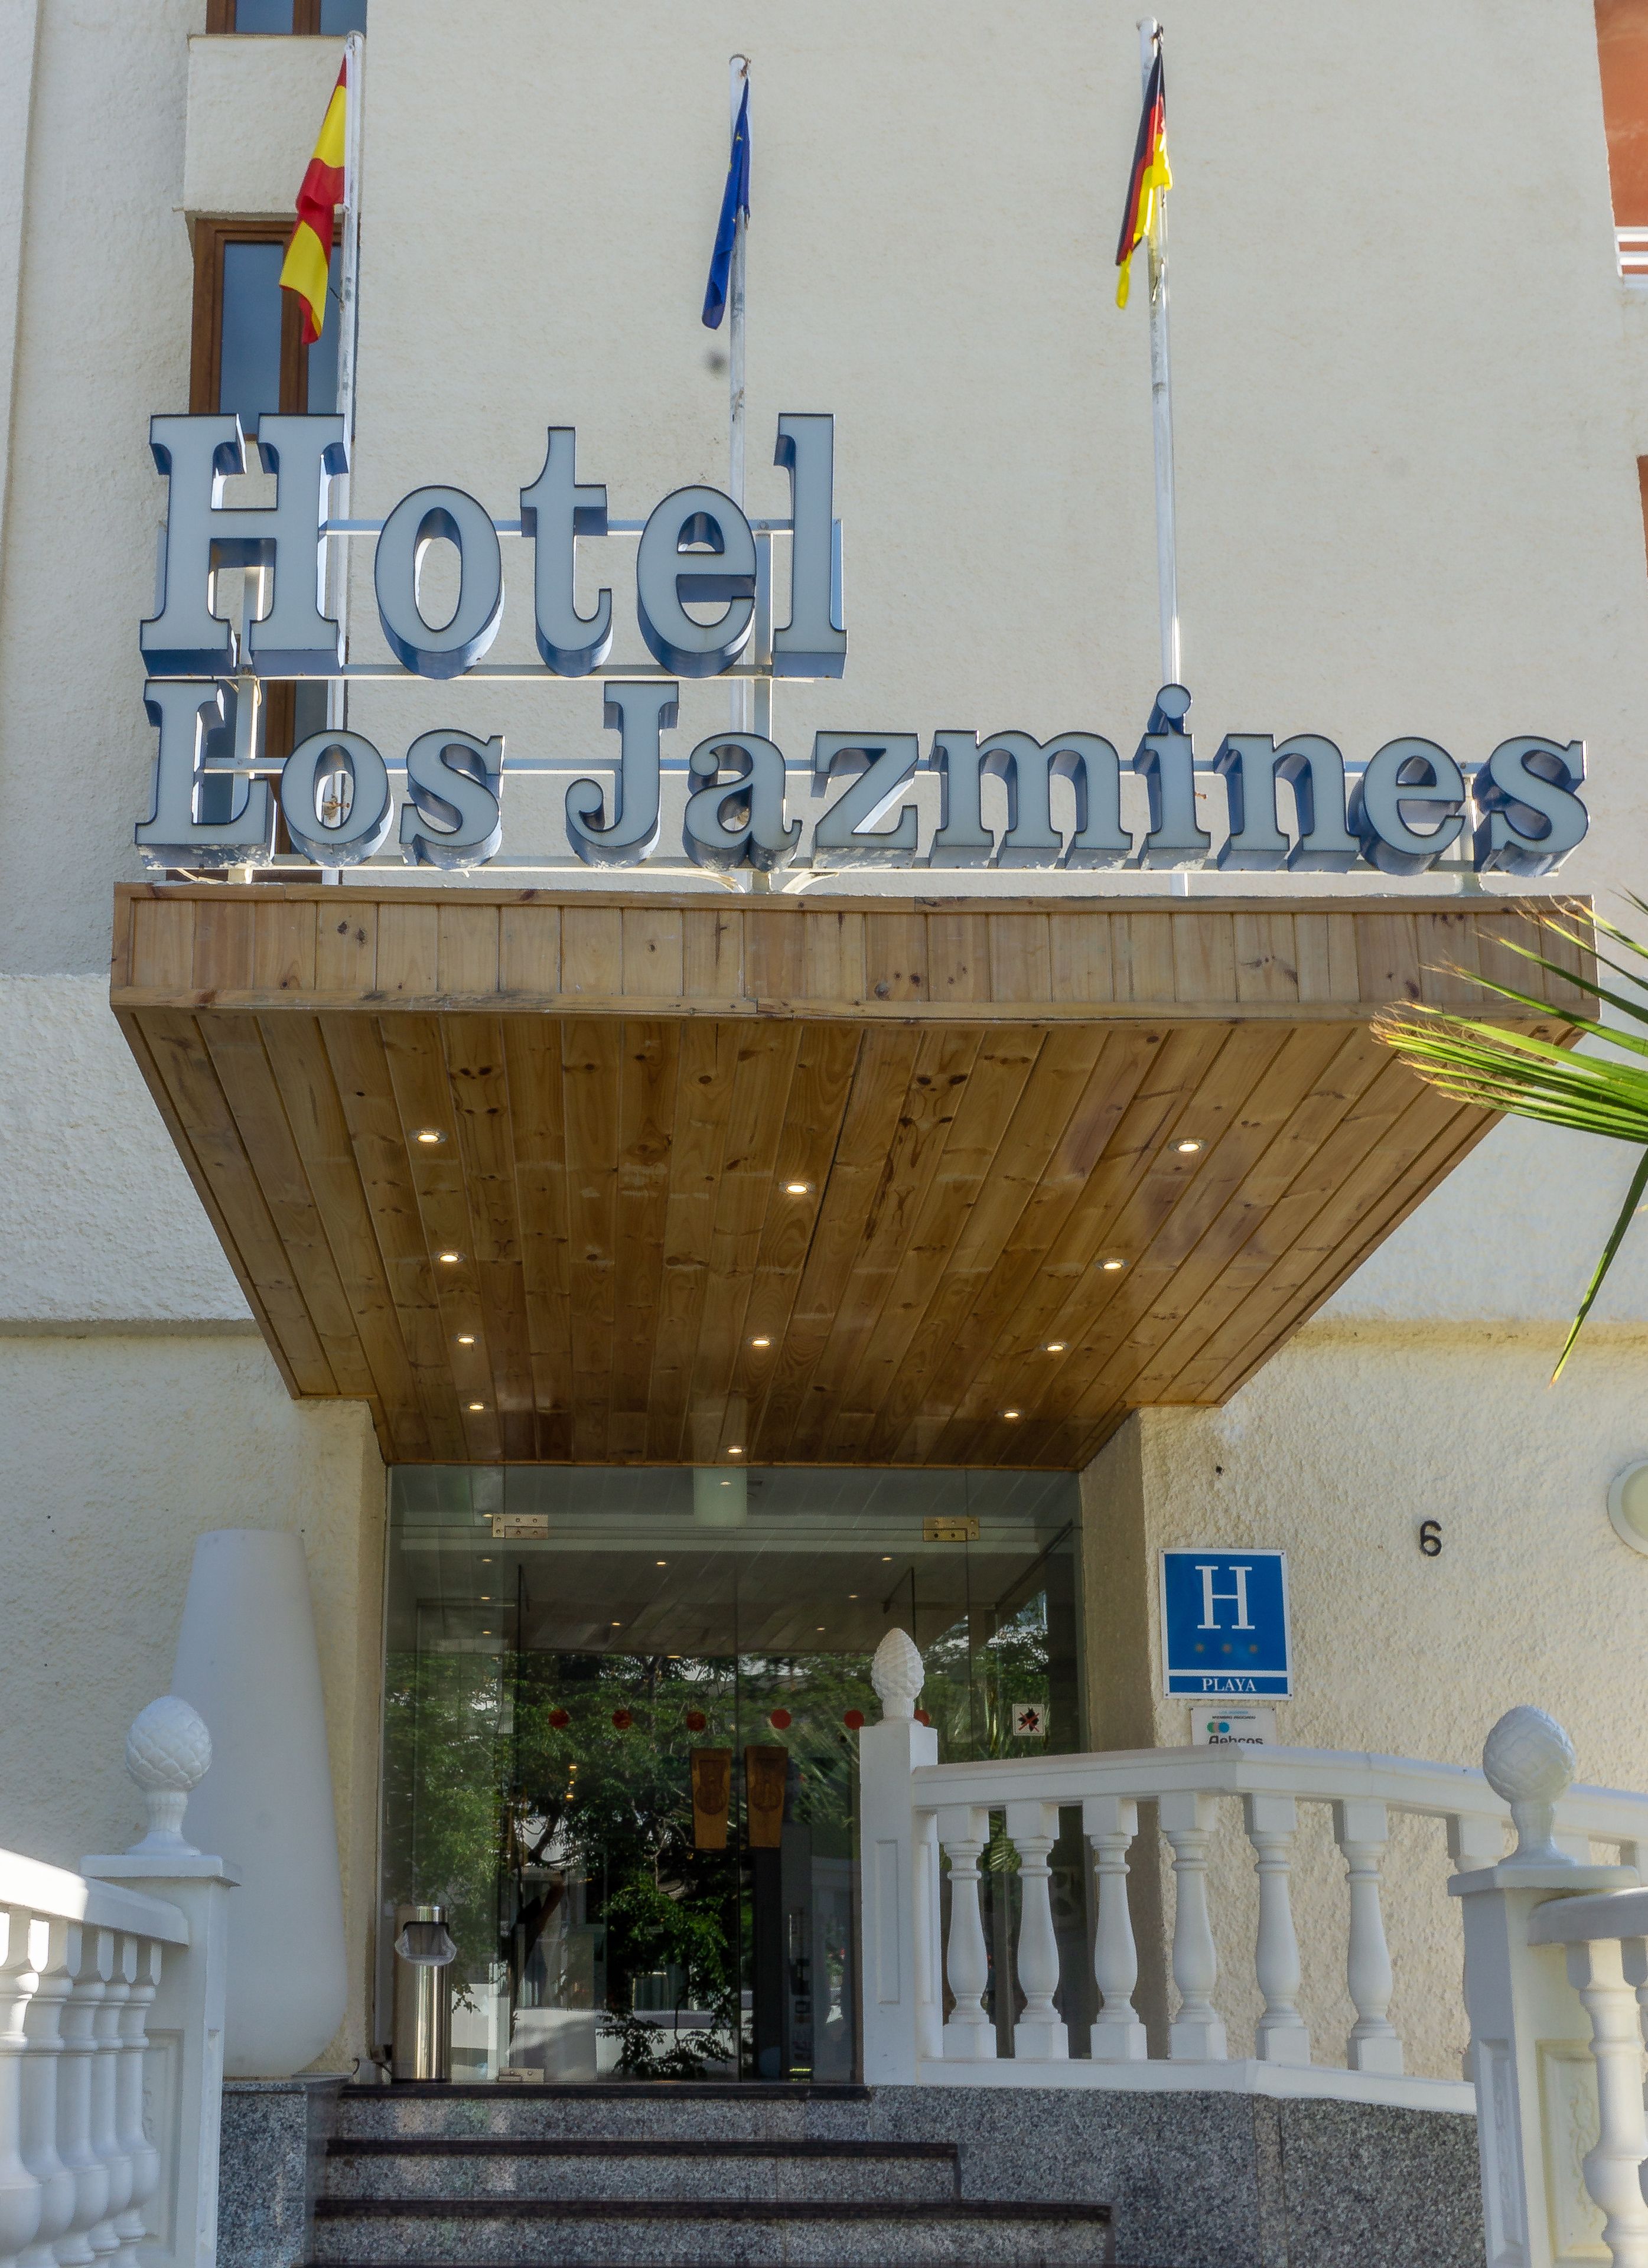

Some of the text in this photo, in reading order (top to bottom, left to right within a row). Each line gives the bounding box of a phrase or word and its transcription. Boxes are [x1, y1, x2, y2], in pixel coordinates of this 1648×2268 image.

[139, 411, 848, 664] Hotel
[134, 678, 1590, 860] Los Jazmines
[1419, 1519, 1442, 1557] 6
[1194, 1565, 1256, 1630] H
[1201, 1677, 1257, 1692] PLAYA
